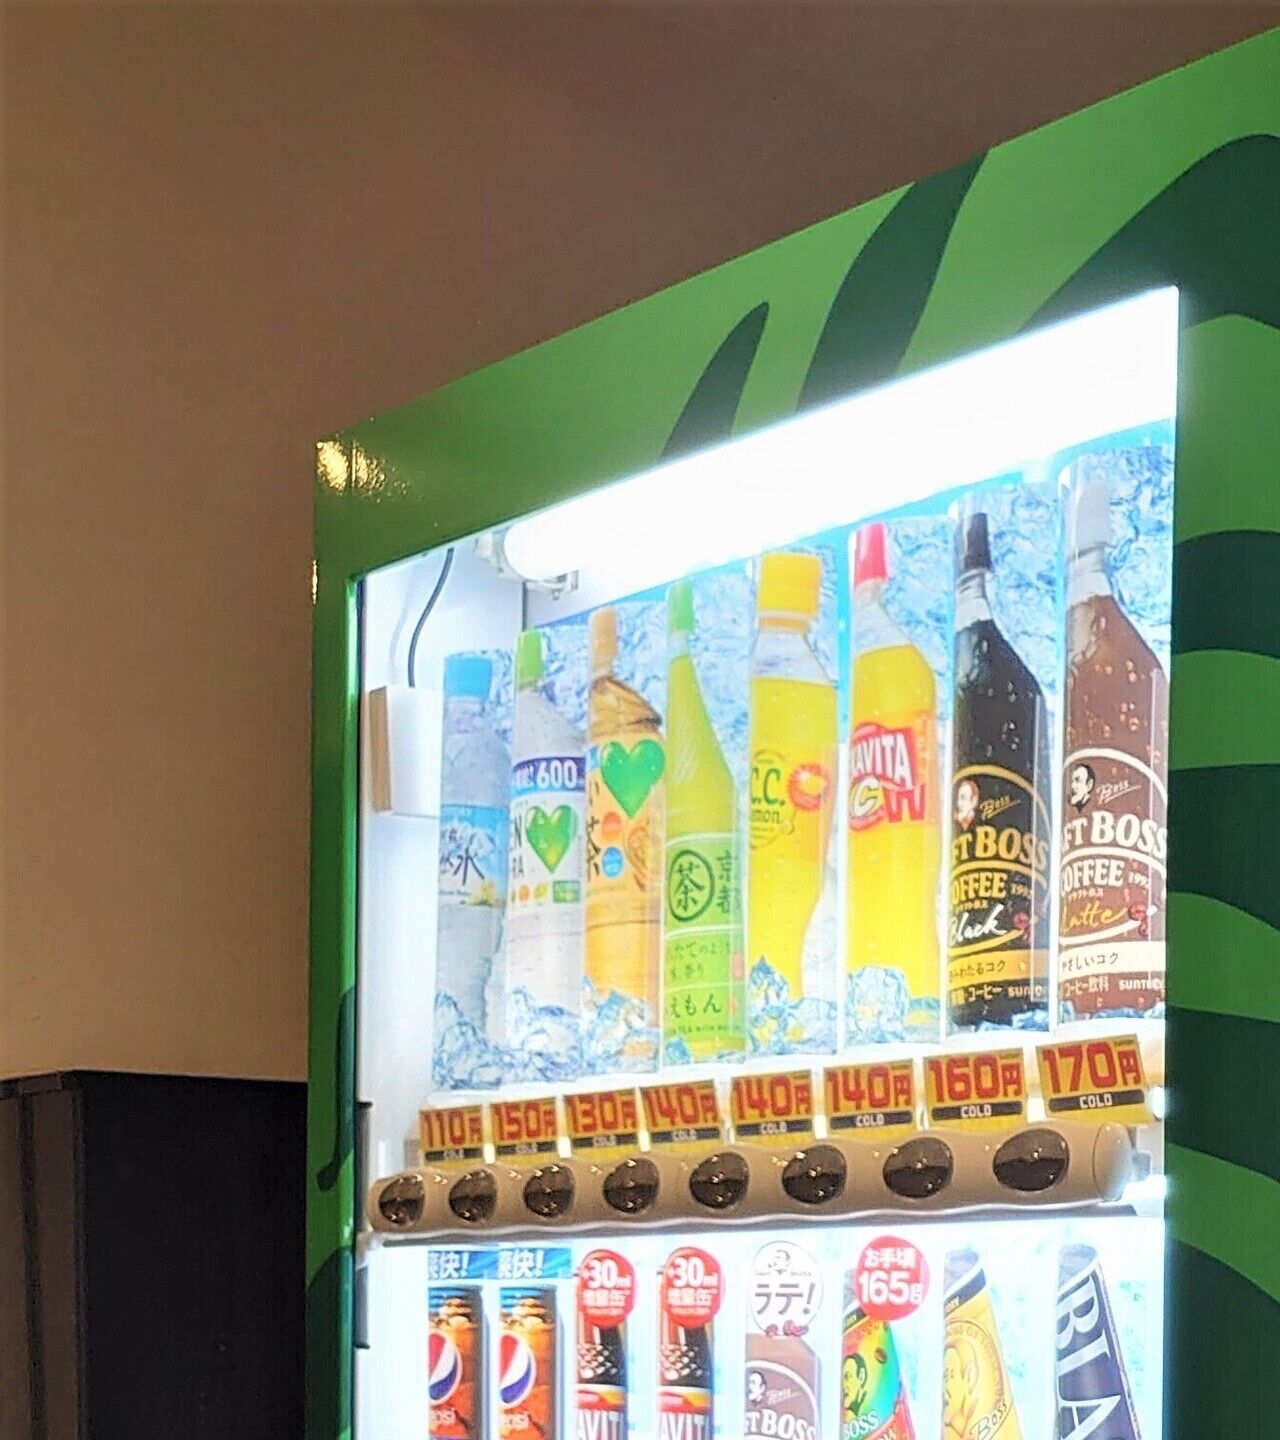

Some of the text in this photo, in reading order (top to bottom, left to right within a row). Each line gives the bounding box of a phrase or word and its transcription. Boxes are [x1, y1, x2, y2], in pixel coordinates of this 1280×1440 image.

[535, 758, 577, 787] 600
[975, 824, 1048, 872] BOSS
[1091, 811, 1168, 859] BOSS
[826, 1066, 912, 1114] 140円
[928, 1053, 1023, 1103] 160円
[1041, 1041, 1142, 1095] 170円
[733, 1074, 812, 1120] 140円
[960, 1104, 992, 1118] COLD
[1079, 1095, 1113, 1109] COLD
[855, 1114, 884, 1128] COLD
